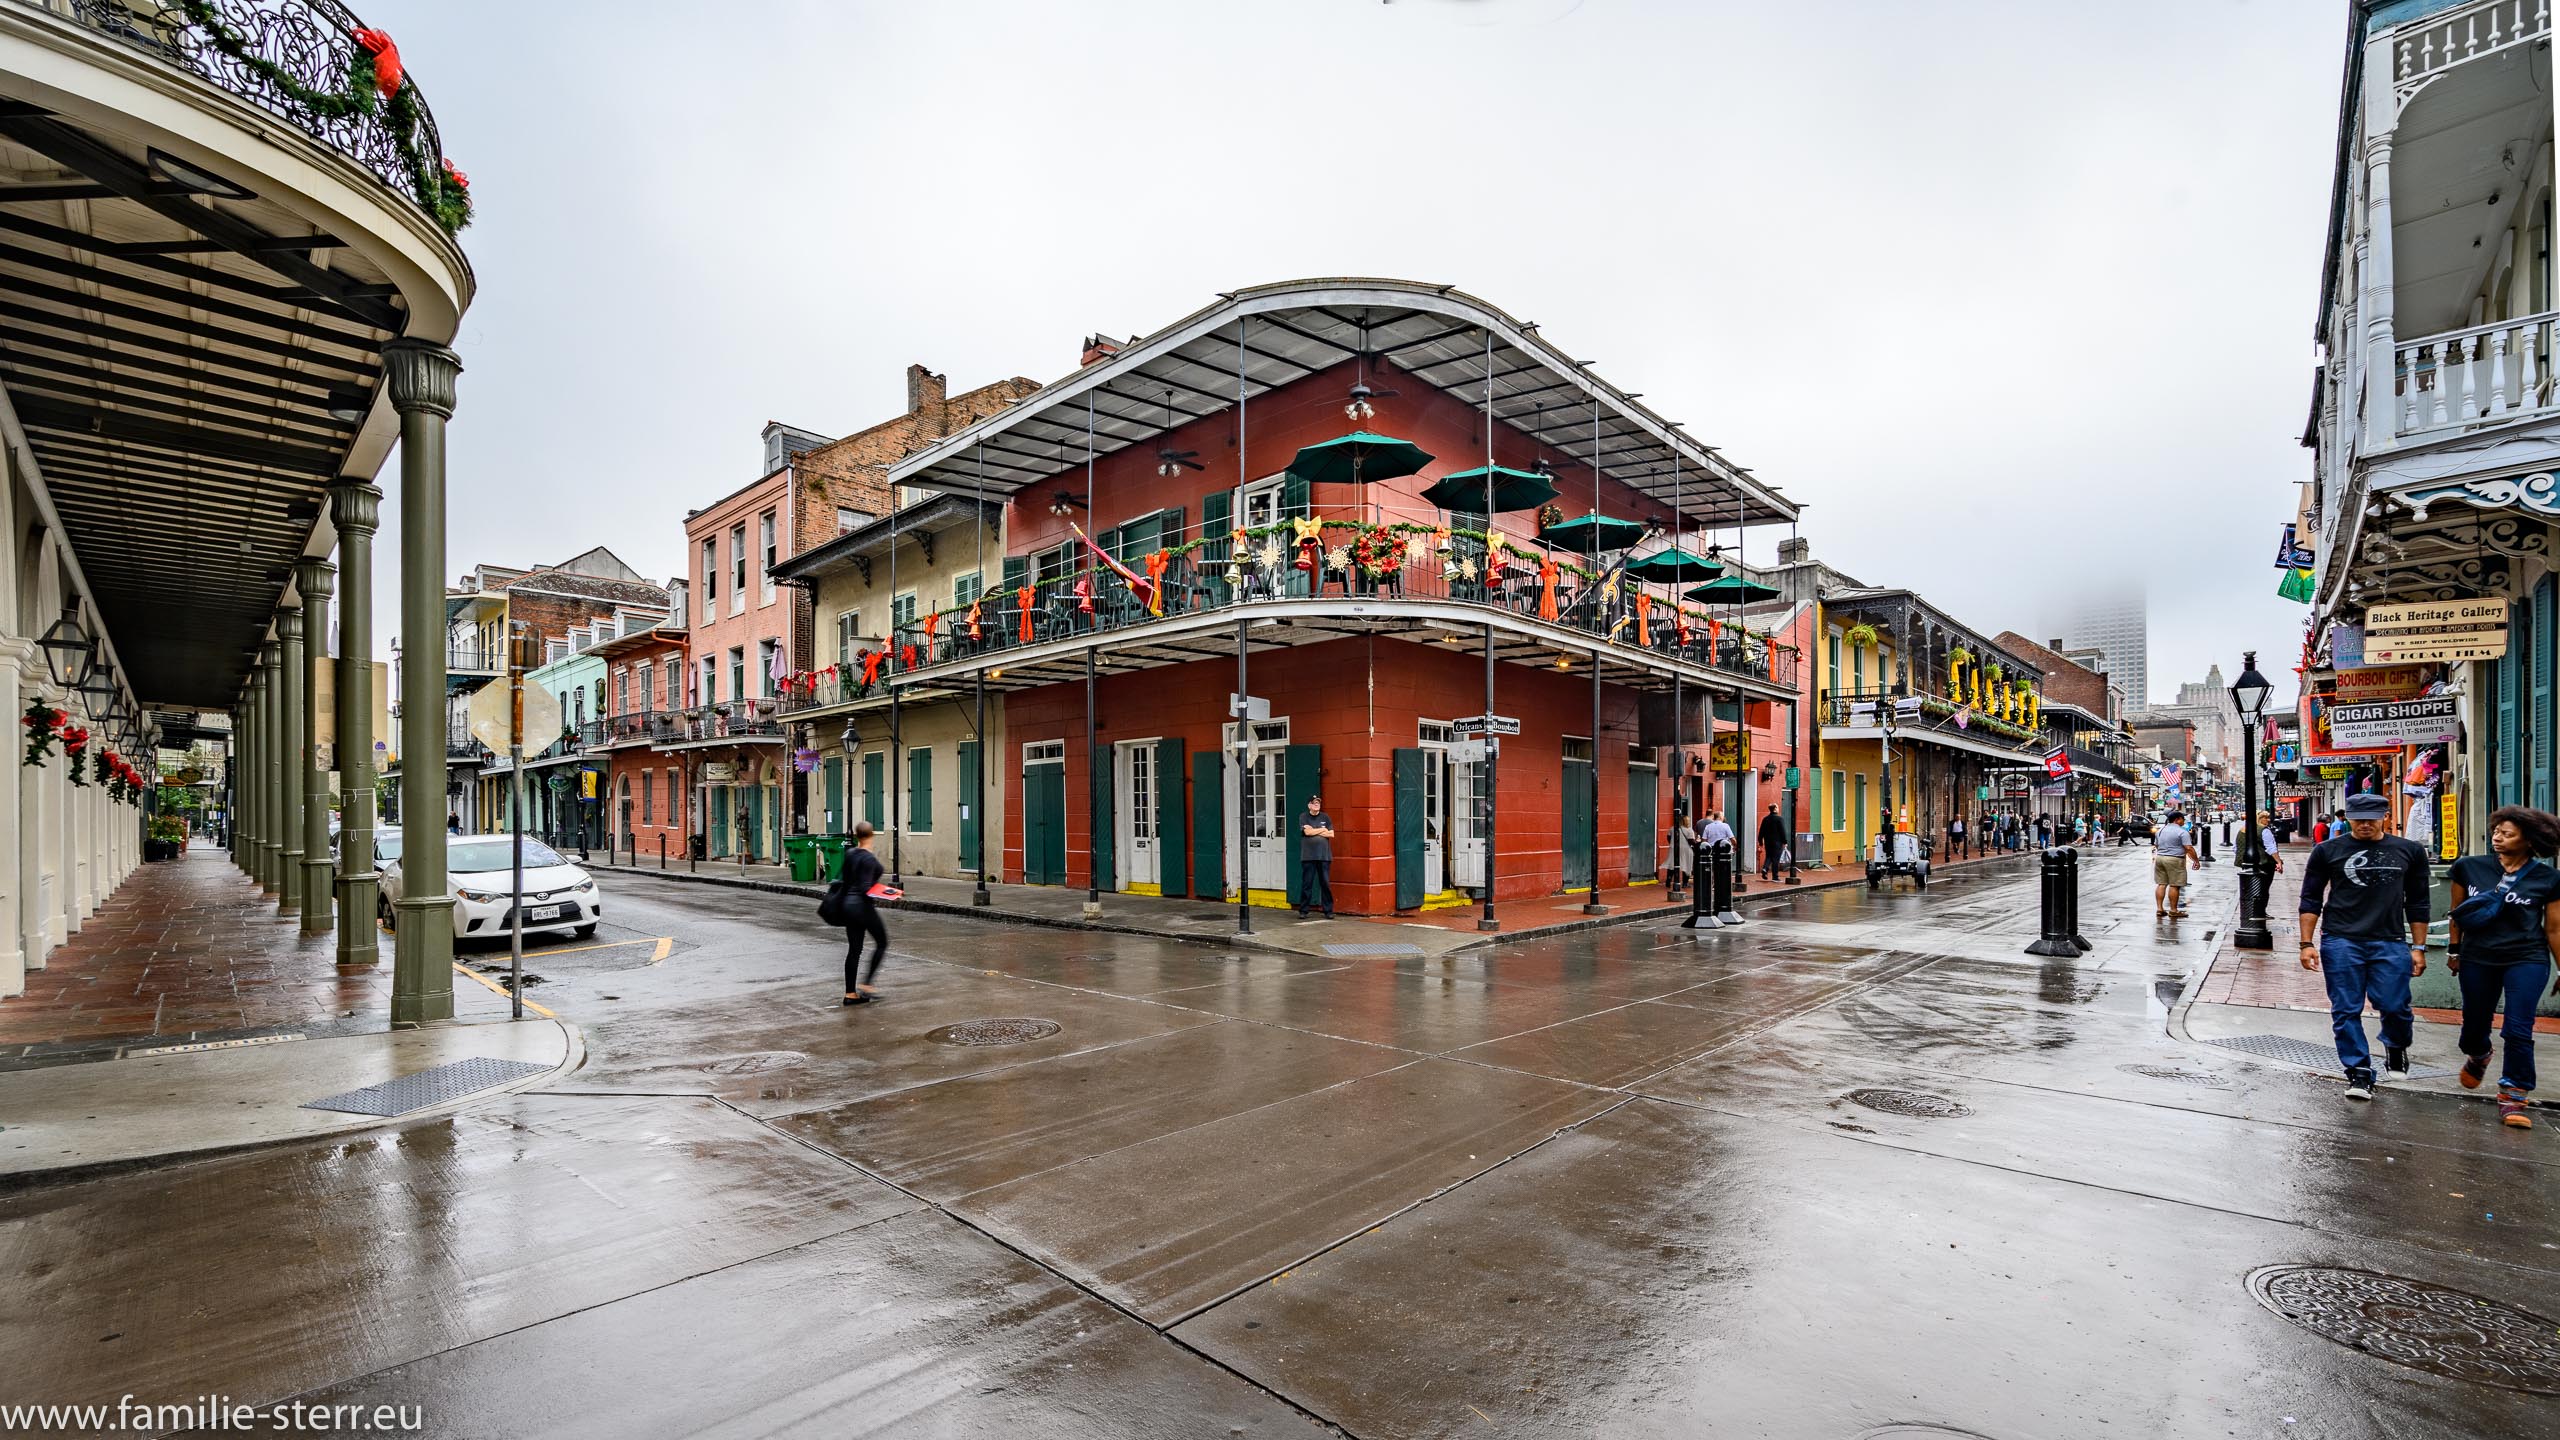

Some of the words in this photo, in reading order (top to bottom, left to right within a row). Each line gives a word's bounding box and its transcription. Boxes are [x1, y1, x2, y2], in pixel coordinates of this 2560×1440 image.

[2372, 612, 2402, 623] Black
[2407, 609, 2455, 621] Heritage
[2461, 606, 2504, 618] Gallery
[2375, 628, 2409, 636] SPECIALIZING
[2419, 624, 2475, 633] AFRICAN-AMERICAN
[2476, 623, 2496, 631] PRINTS
[2400, 651, 2447, 660] KODAK
[2455, 649, 2491, 657] FILM
[2337, 671, 2386, 687] BOURBON
[2389, 669, 2419, 685] GIFTS
[2336, 707, 2383, 721] CIGAR
[2388, 701, 2453, 718] SHOPPE
[1455, 721, 1483, 731] Orleans
[1493, 721, 1519, 733] Bourbon
[2334, 724, 2367, 732] HOOKAH
[2404, 717, 2456, 727] CIGARETTES
[2368, 729, 2400, 737] DRINKS
[2407, 726, 2445, 734] T-SHIRTS
[2505, 892, 2531, 905] One
